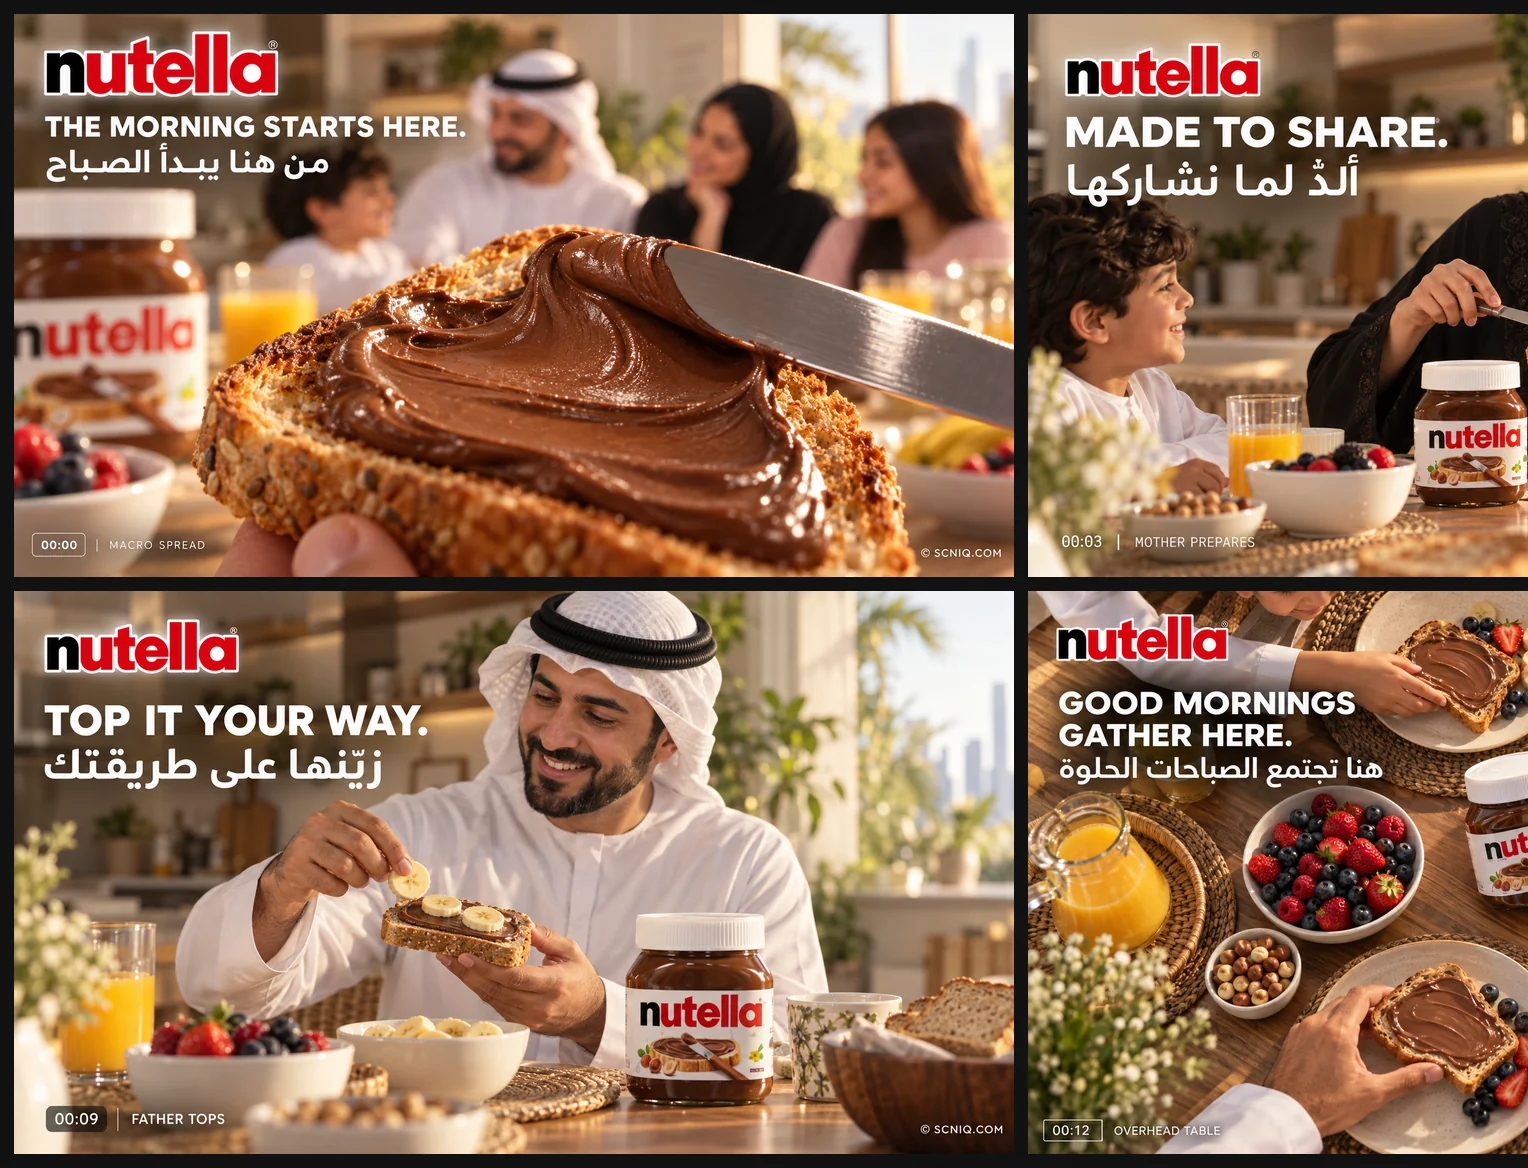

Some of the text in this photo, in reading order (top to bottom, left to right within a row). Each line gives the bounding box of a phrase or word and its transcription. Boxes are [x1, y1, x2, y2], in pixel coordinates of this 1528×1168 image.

[14, 306, 194, 360] nutella
[1428, 422, 1521, 449] nutella
[639, 994, 763, 1029] nutella
